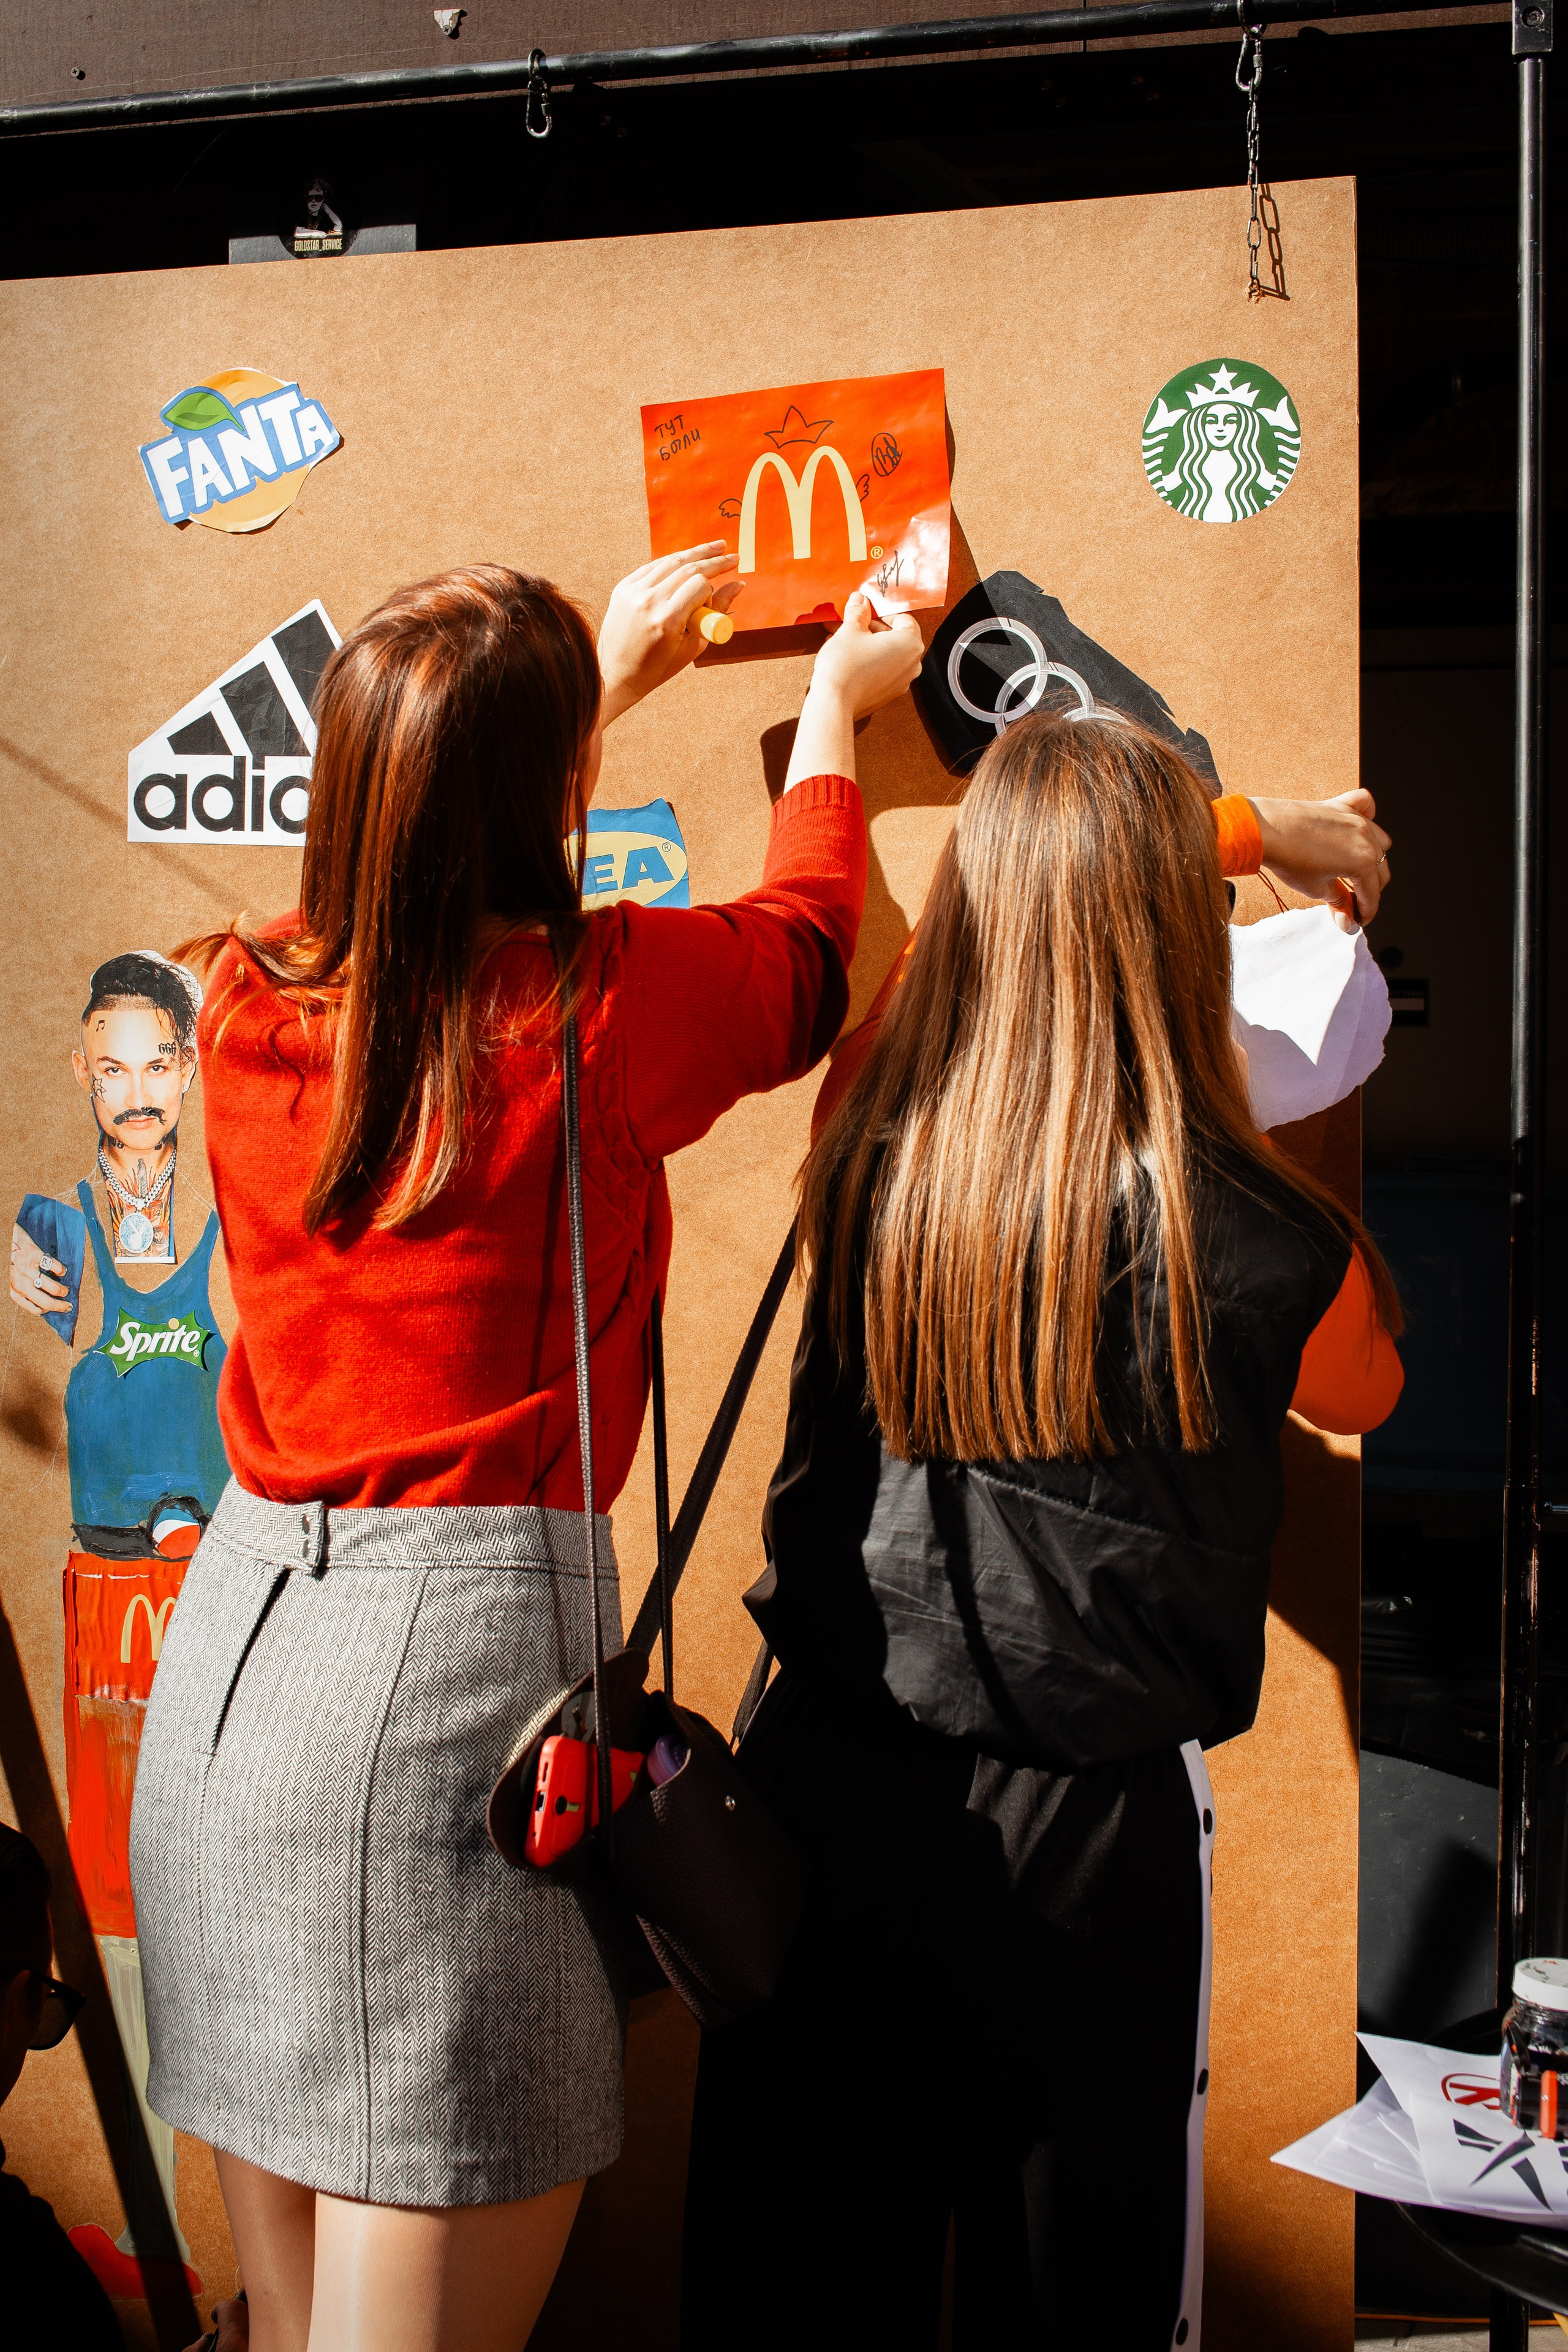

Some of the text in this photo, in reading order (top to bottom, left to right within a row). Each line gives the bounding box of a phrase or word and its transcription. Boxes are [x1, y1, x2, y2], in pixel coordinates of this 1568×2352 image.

[146, 390, 334, 518] FANTA
[575, 846, 675, 895] EA
[109, 1317, 200, 1361] Sprite
